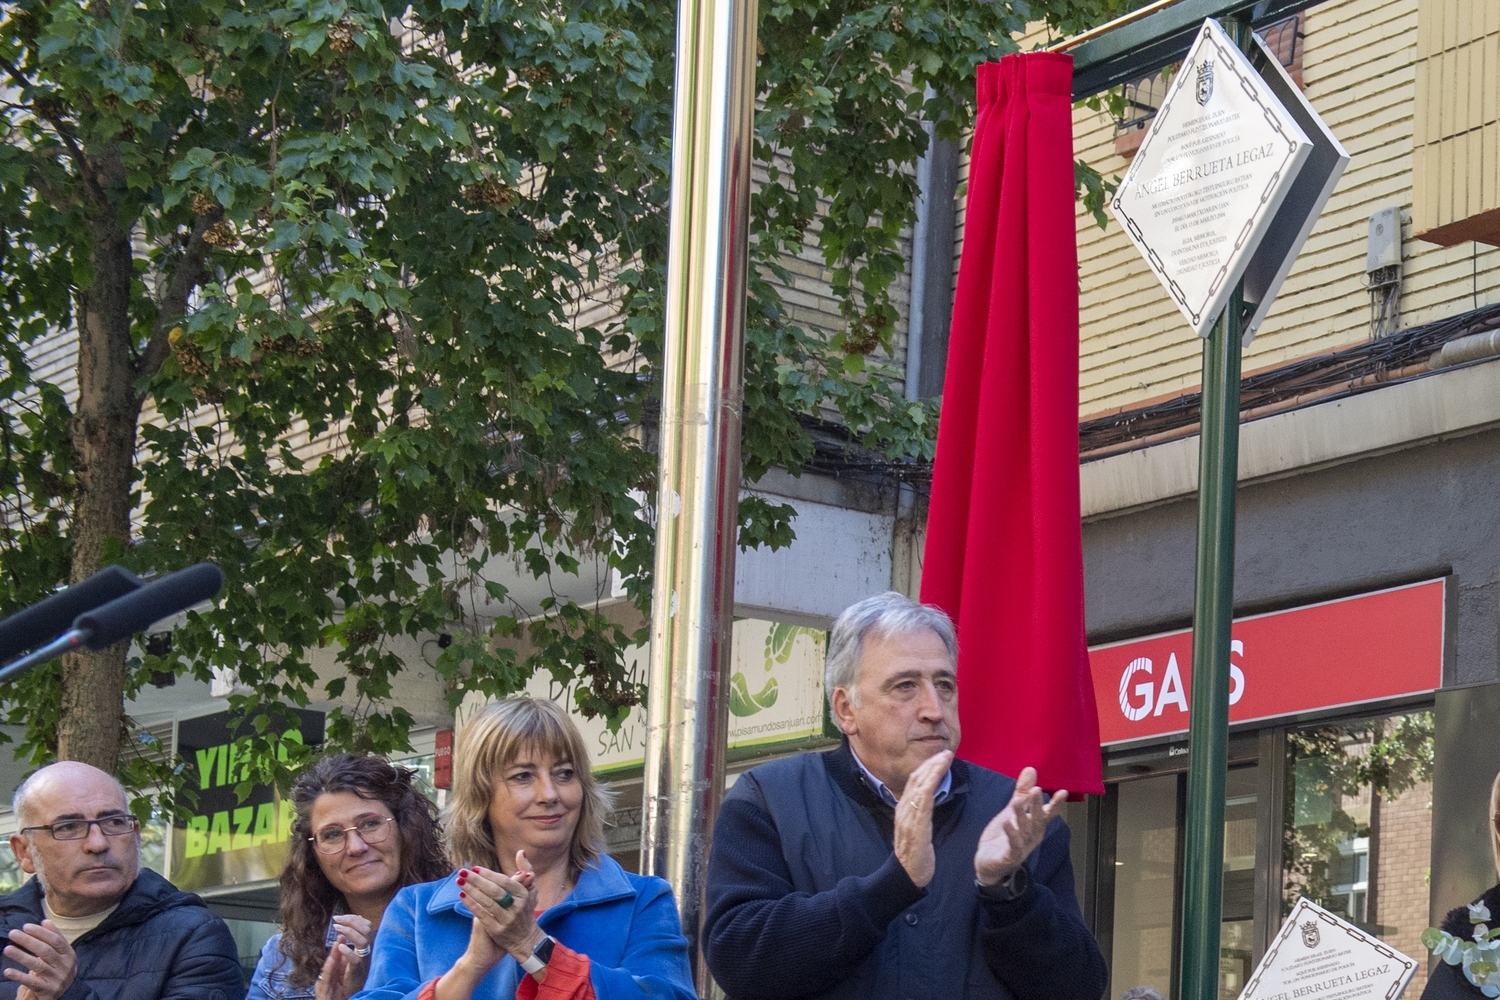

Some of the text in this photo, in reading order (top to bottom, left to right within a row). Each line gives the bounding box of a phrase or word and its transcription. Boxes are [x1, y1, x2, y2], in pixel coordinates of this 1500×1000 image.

[1134, 142, 1273, 201] ÁNGEL BERRUETA LEGAZ
[1119, 639, 1246, 722] GAS
[597, 725, 635, 757] SAN
[185, 799, 299, 859] BAZAR
[1292, 975, 1353, 998] BERRUETA
[1355, 964, 1390, 981] LEGAZ
